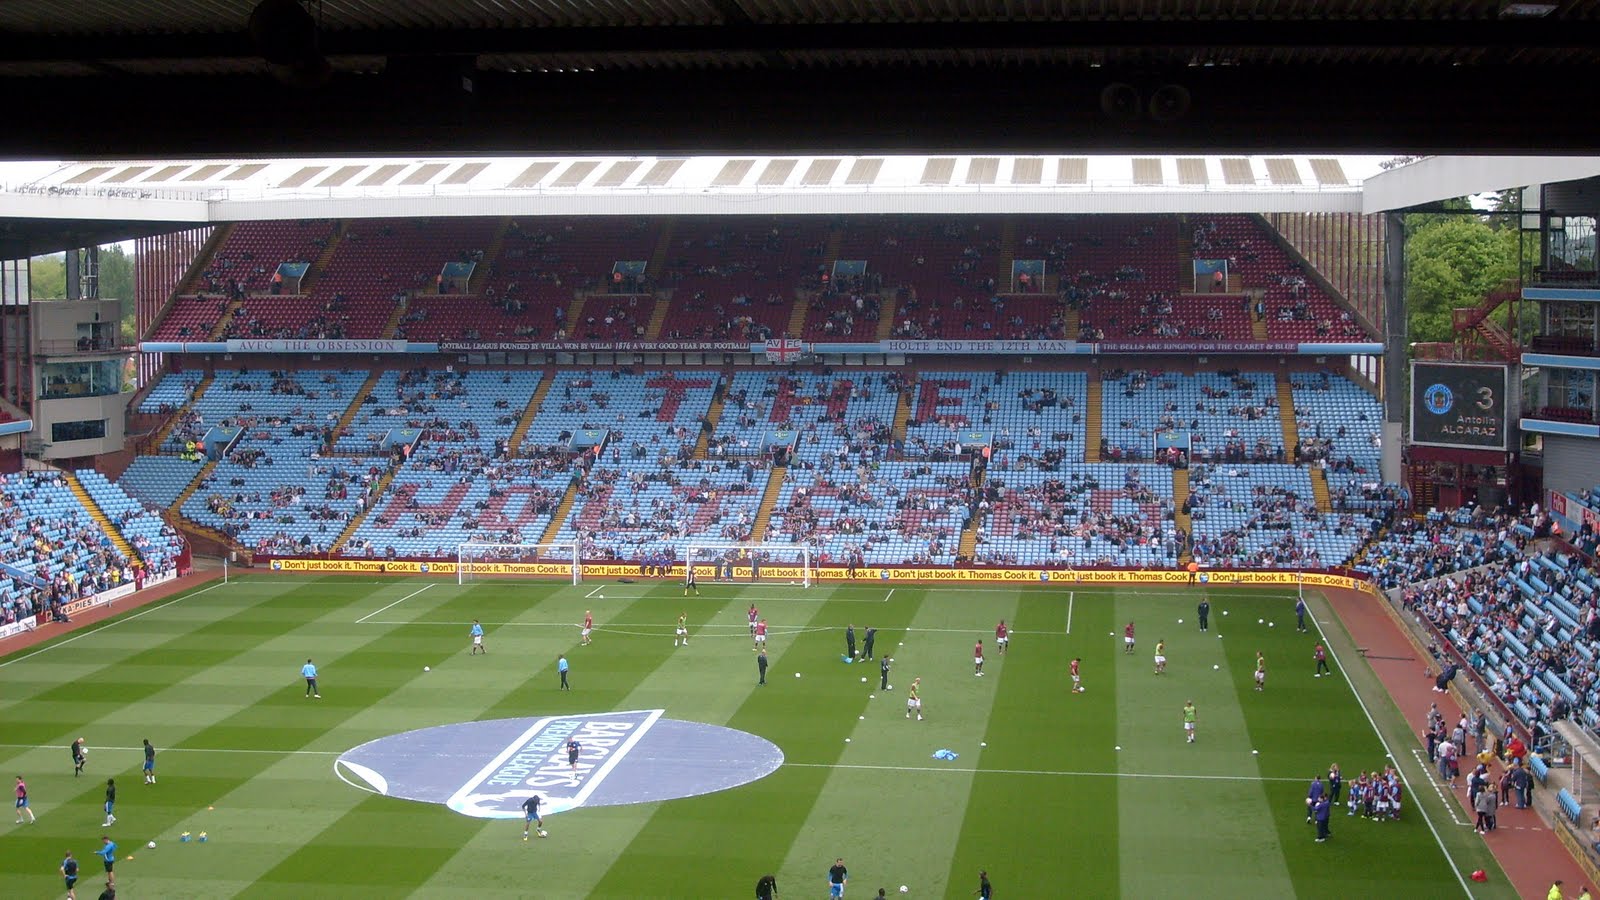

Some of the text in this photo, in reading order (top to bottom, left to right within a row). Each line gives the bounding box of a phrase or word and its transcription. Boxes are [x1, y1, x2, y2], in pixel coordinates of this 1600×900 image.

[240, 341, 395, 350] AVFC THE OBSESSION
[439, 342, 472, 350] OOTBALL
[473, 342, 498, 350] LEAGUE
[500, 342, 530, 350] FOUNDED
[531, 342, 539, 350] BY
[564, 342, 579, 350] WON
[581, 342, 588, 350] BY
[615, 342, 630, 350] 1876
[633, 342, 638, 350] A
[640, 342, 658, 350] VERY
[659, 342, 679, 350] GOOD
[680, 342, 698, 350] YEAR
[700, 342, 712, 350] FOR
[889, 341, 1067, 351] HOLTE END THE 12TH MAN
[1476, 386, 1494, 410] 3
[1441, 425, 1496, 437] ALCARAZ
[284, 561, 306, 569] Don't
[307, 561, 321, 570] just
[323, 562, 343, 570] book
[354, 562, 384, 570] Thoma
[387, 563, 408, 571] Cook
[432, 563, 453, 571] Don't
[471, 564, 492, 572] book
[493, 564, 501, 572] it.
[504, 565, 536, 573] Thomas
[537, 565, 558, 573] Cook
[560, 565, 568, 573] it.
[583, 566, 605, 574] Don't
[606, 566, 622, 575] just
[623, 567, 642, 575] boo
[777, 568, 798, 577] book
[869, 570, 877, 578] it.
[893, 570, 917, 578] Don't
[917, 571, 933, 580] just
[935, 571, 956, 579] book
[958, 571, 966, 579] it.
[968, 571, 1001, 579] Thomas
[1004, 571, 1027, 579] Cook
[1053, 572, 1188, 581] Don't just book it. Thomas Cook
[1212, 573, 1235, 581] Don't
[1255, 574, 1277, 582] book
[1289, 574, 1323, 584] Thomas
[1324, 576, 1344, 586] Cook
[486, 720, 583, 786] PREMIER LEAGUE
[525, 721, 635, 788] BARCLAYS
